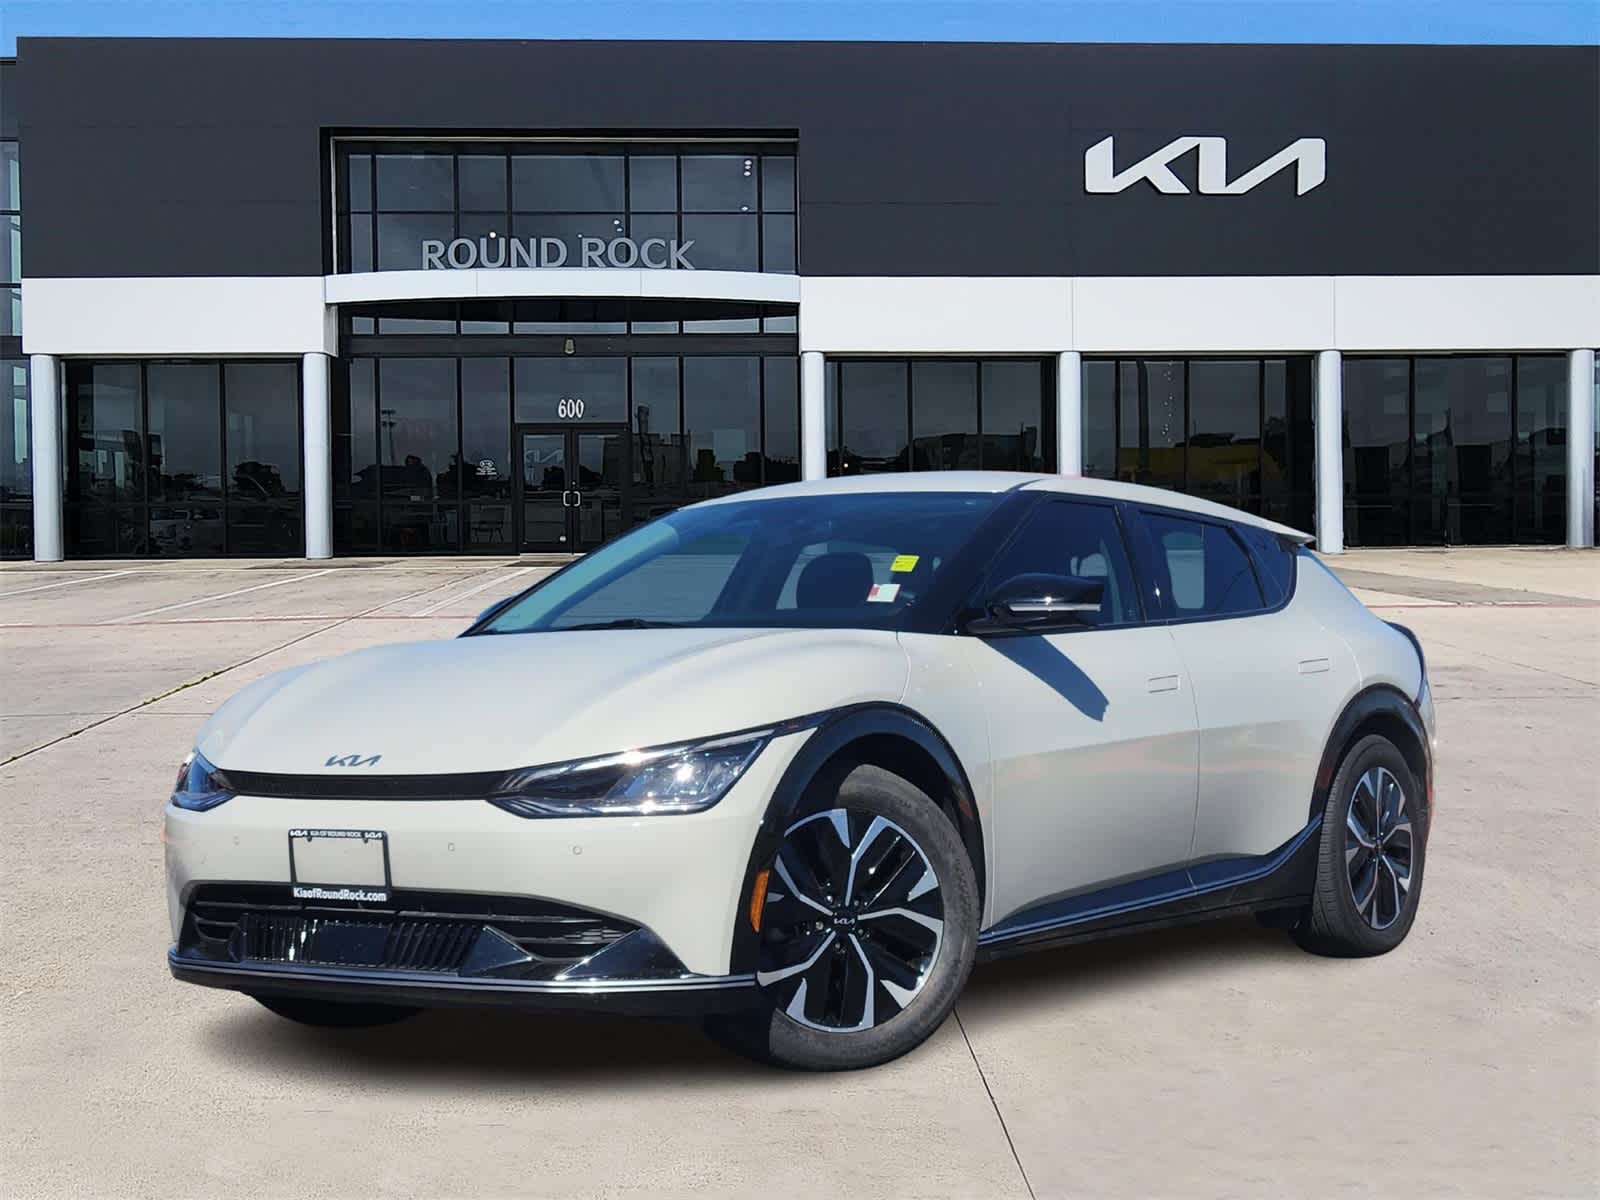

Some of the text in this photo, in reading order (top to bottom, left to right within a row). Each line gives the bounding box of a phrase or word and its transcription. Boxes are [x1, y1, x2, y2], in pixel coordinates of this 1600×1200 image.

[1085, 135, 1326, 196] KIA
[422, 238, 695, 270] ROUND ROCK
[558, 399, 584, 418] 600
[325, 755, 382, 766] KIA
[293, 887, 387, 902] KiaofRoundRock.com
